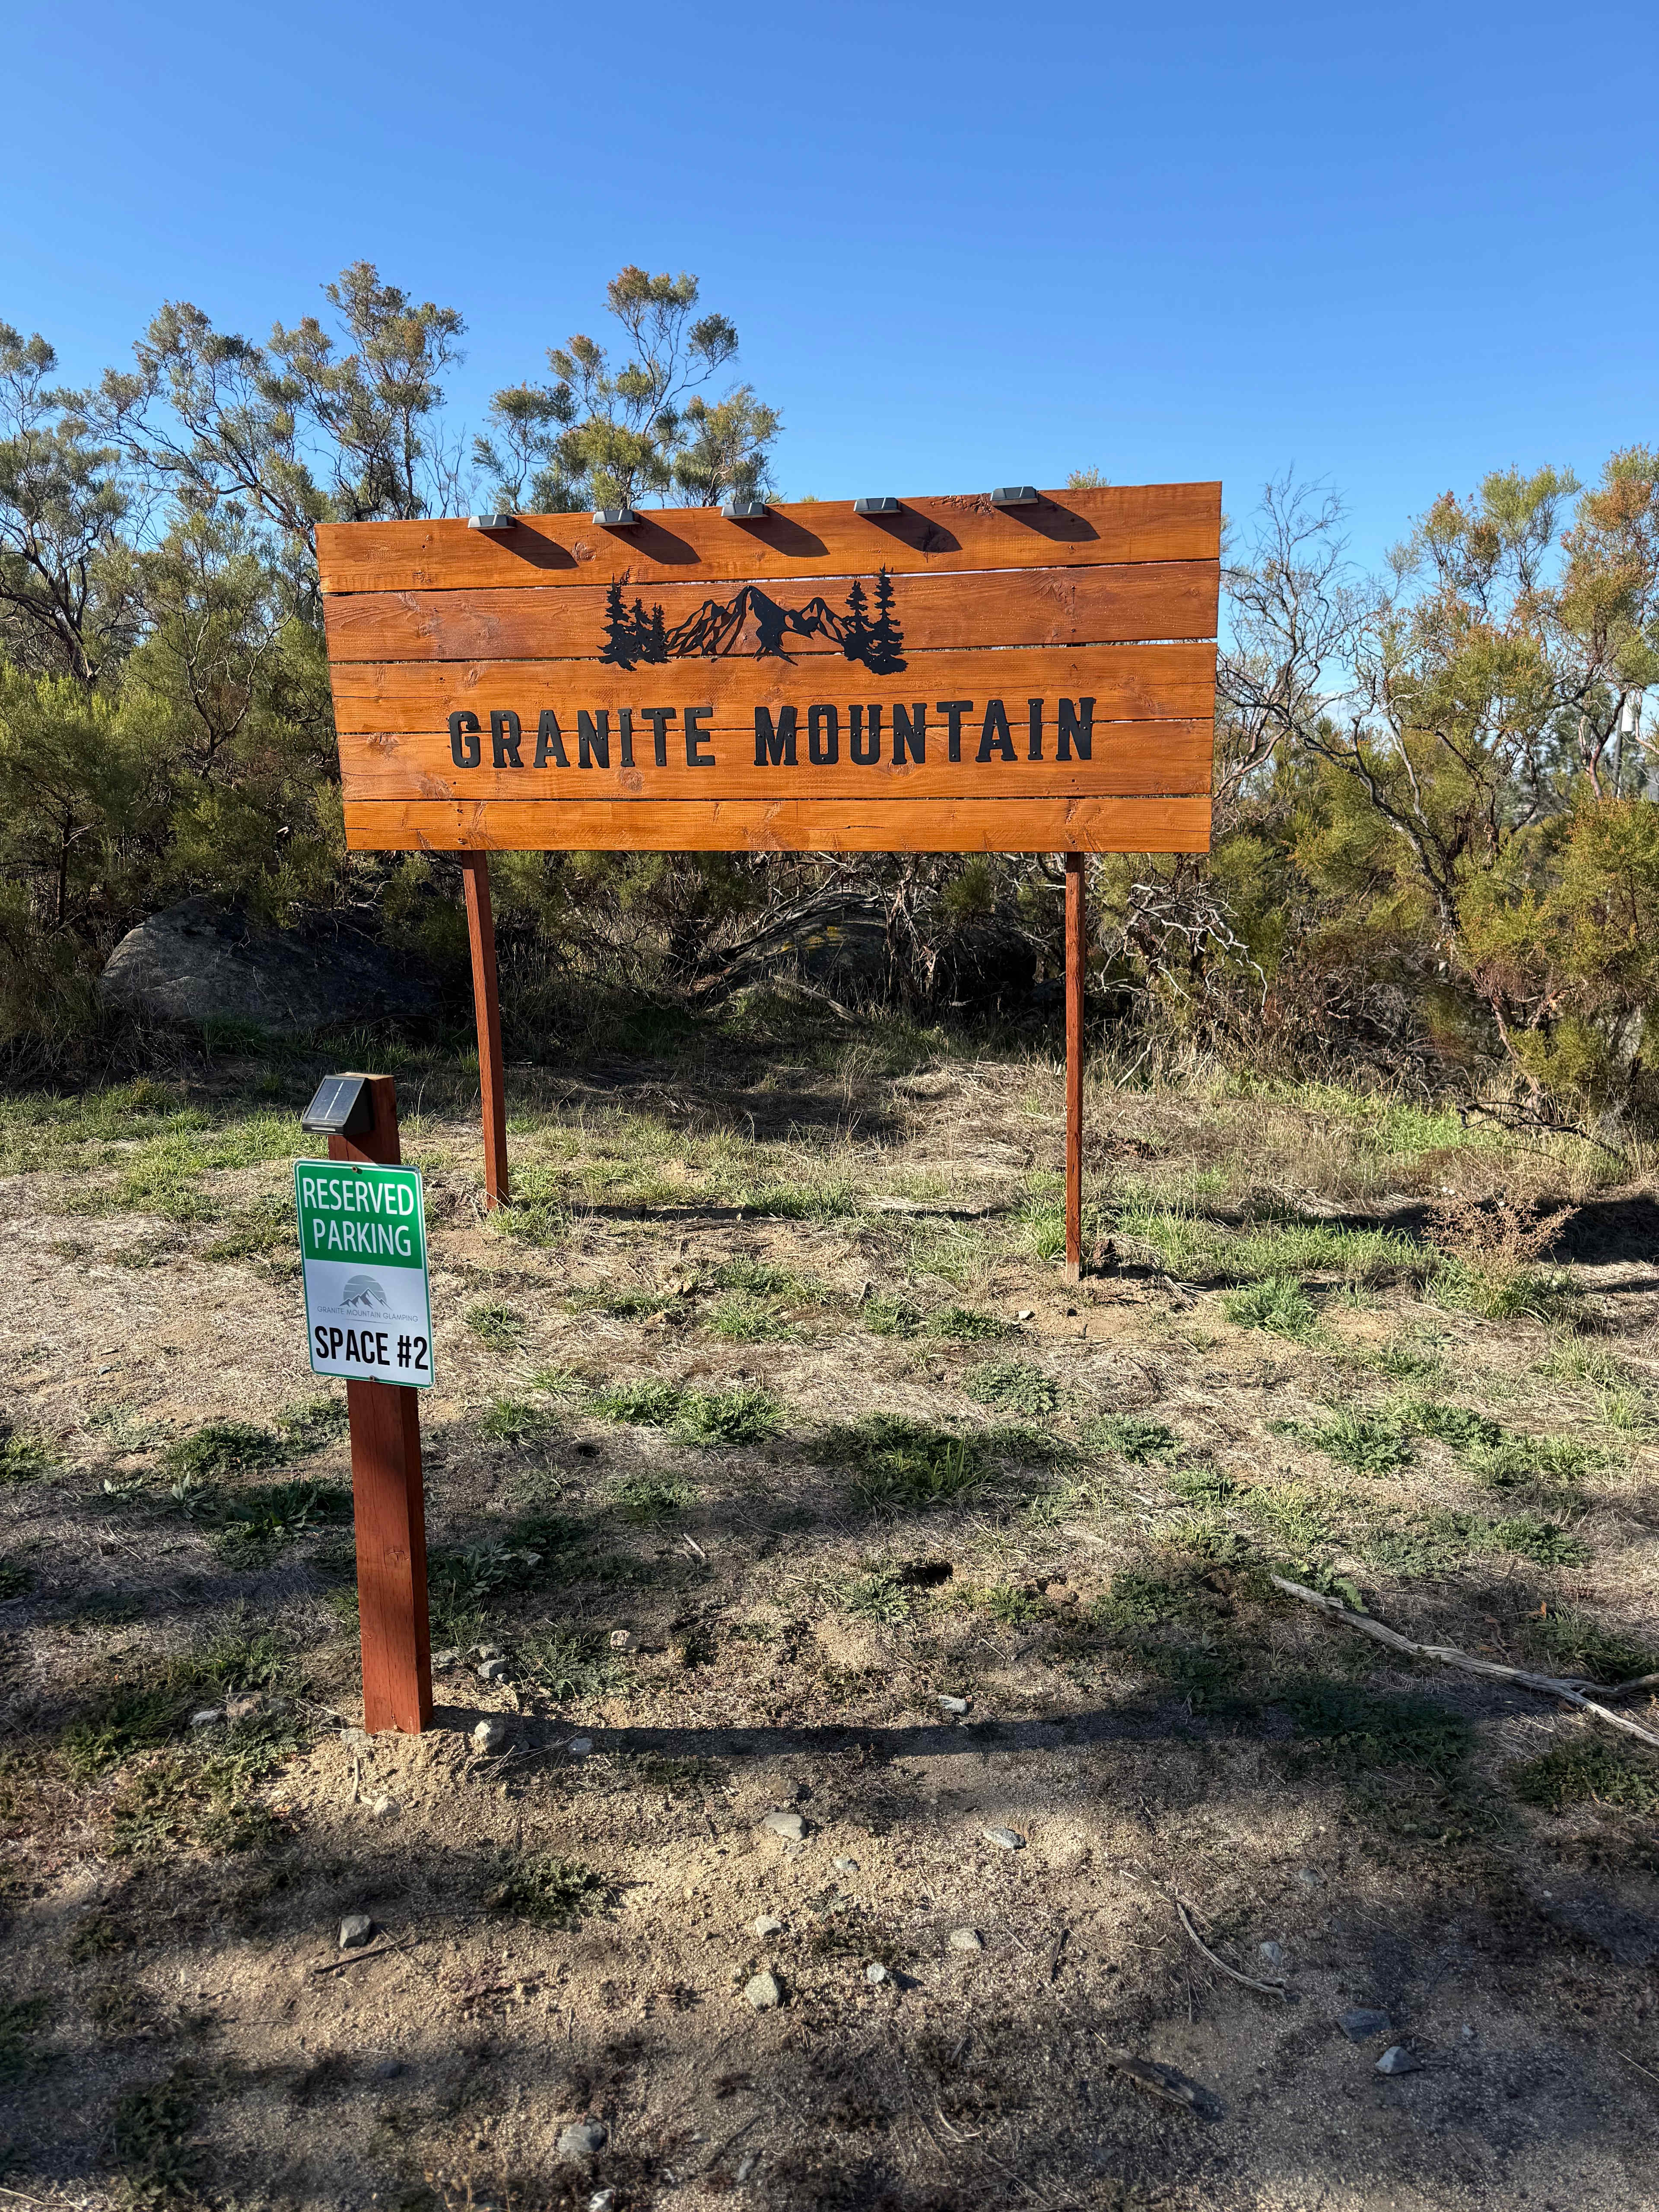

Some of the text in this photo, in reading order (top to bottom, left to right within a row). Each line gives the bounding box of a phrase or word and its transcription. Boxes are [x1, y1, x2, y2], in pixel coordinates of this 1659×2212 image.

[448, 697, 1096, 769] GRANITE MOUNTAIN
[303, 1177, 414, 1216] RESERVED
[313, 1218, 411, 1256] PARKING
[317, 1306, 418, 1322] GRANITE MOUNTAIN GLAMPING
[315, 1325, 429, 1370] SPACE #2
